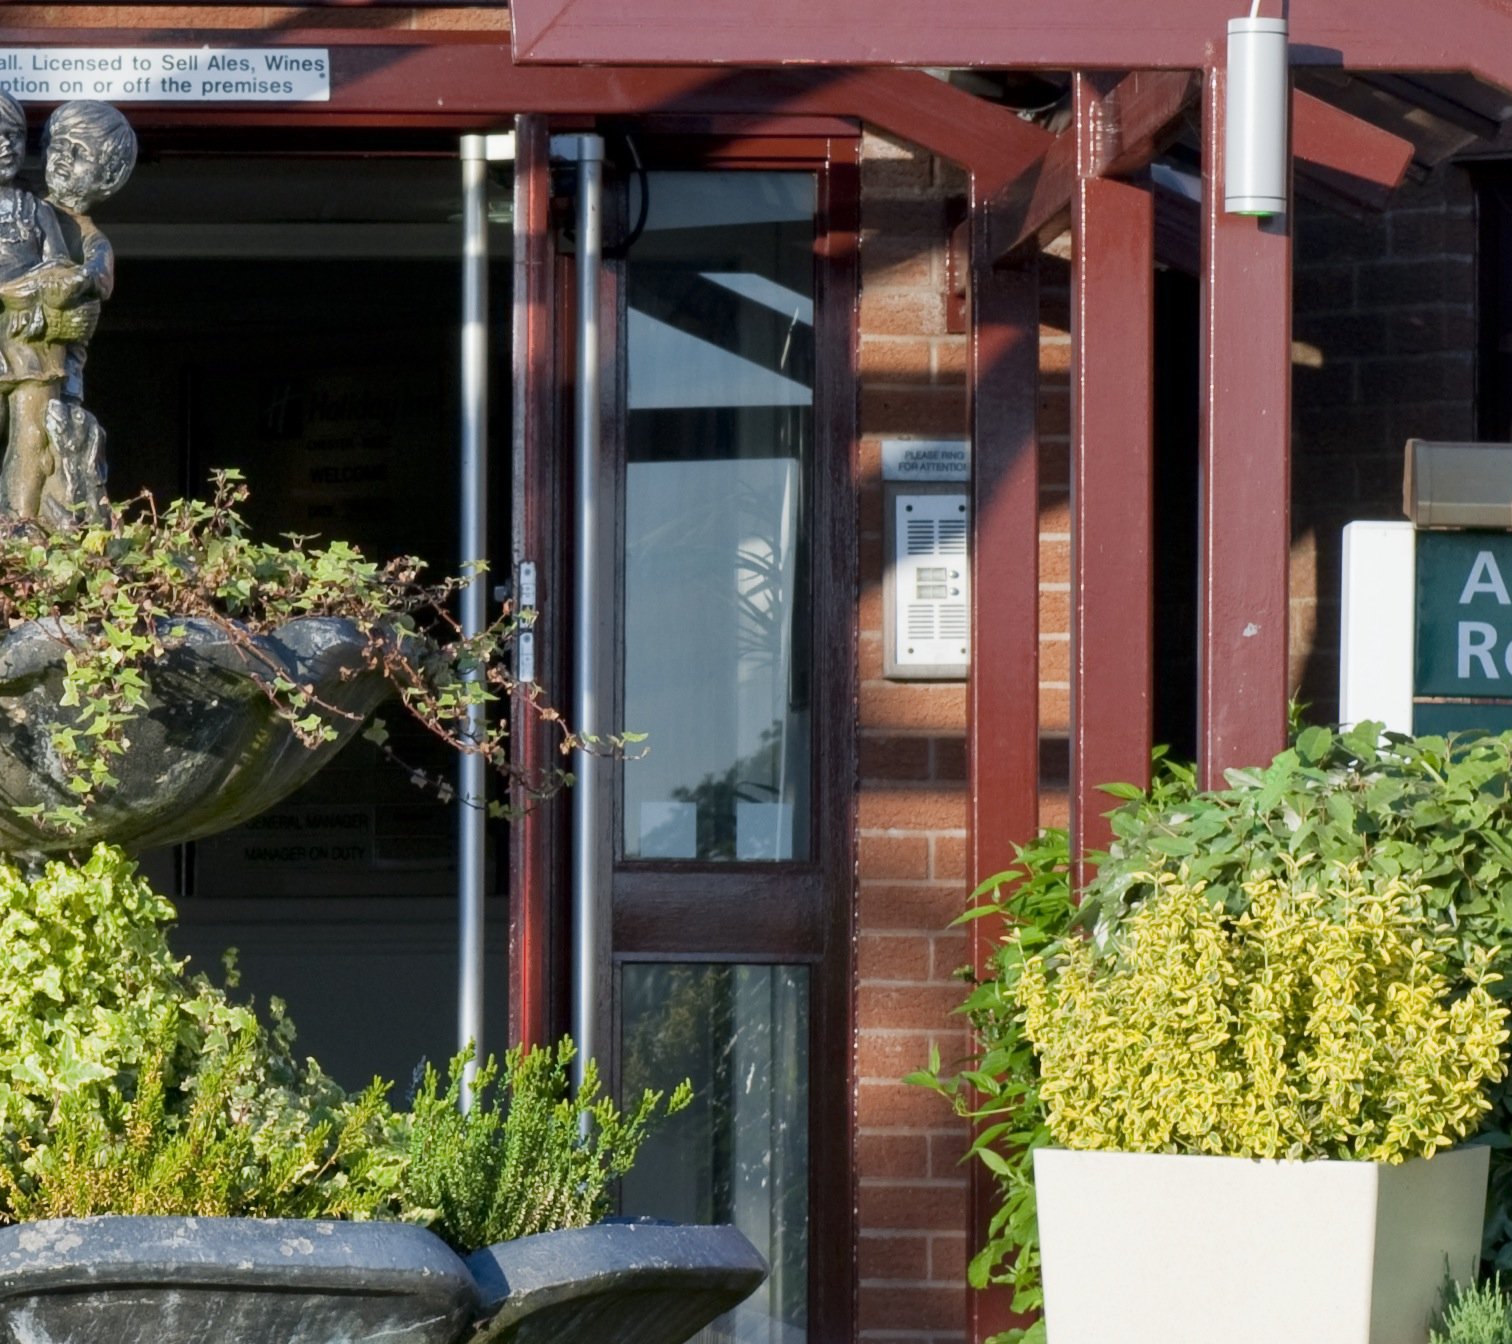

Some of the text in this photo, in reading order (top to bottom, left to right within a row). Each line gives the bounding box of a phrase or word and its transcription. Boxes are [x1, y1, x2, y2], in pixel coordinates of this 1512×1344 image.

[32, 54, 123, 71] Licensed
[133, 56, 152, 71] to
[161, 54, 198, 71] Sell
[207, 55, 256, 74] Ales,
[264, 55, 325, 72] Wines
[59, 80, 84, 93] on
[93, 80, 113, 93] or
[122, 77, 152, 93] off
[161, 78, 193, 93] the
[201, 77, 294, 96] premises
[904, 450, 965, 460] PLEASE RING
[898, 462, 918, 471] FOR
